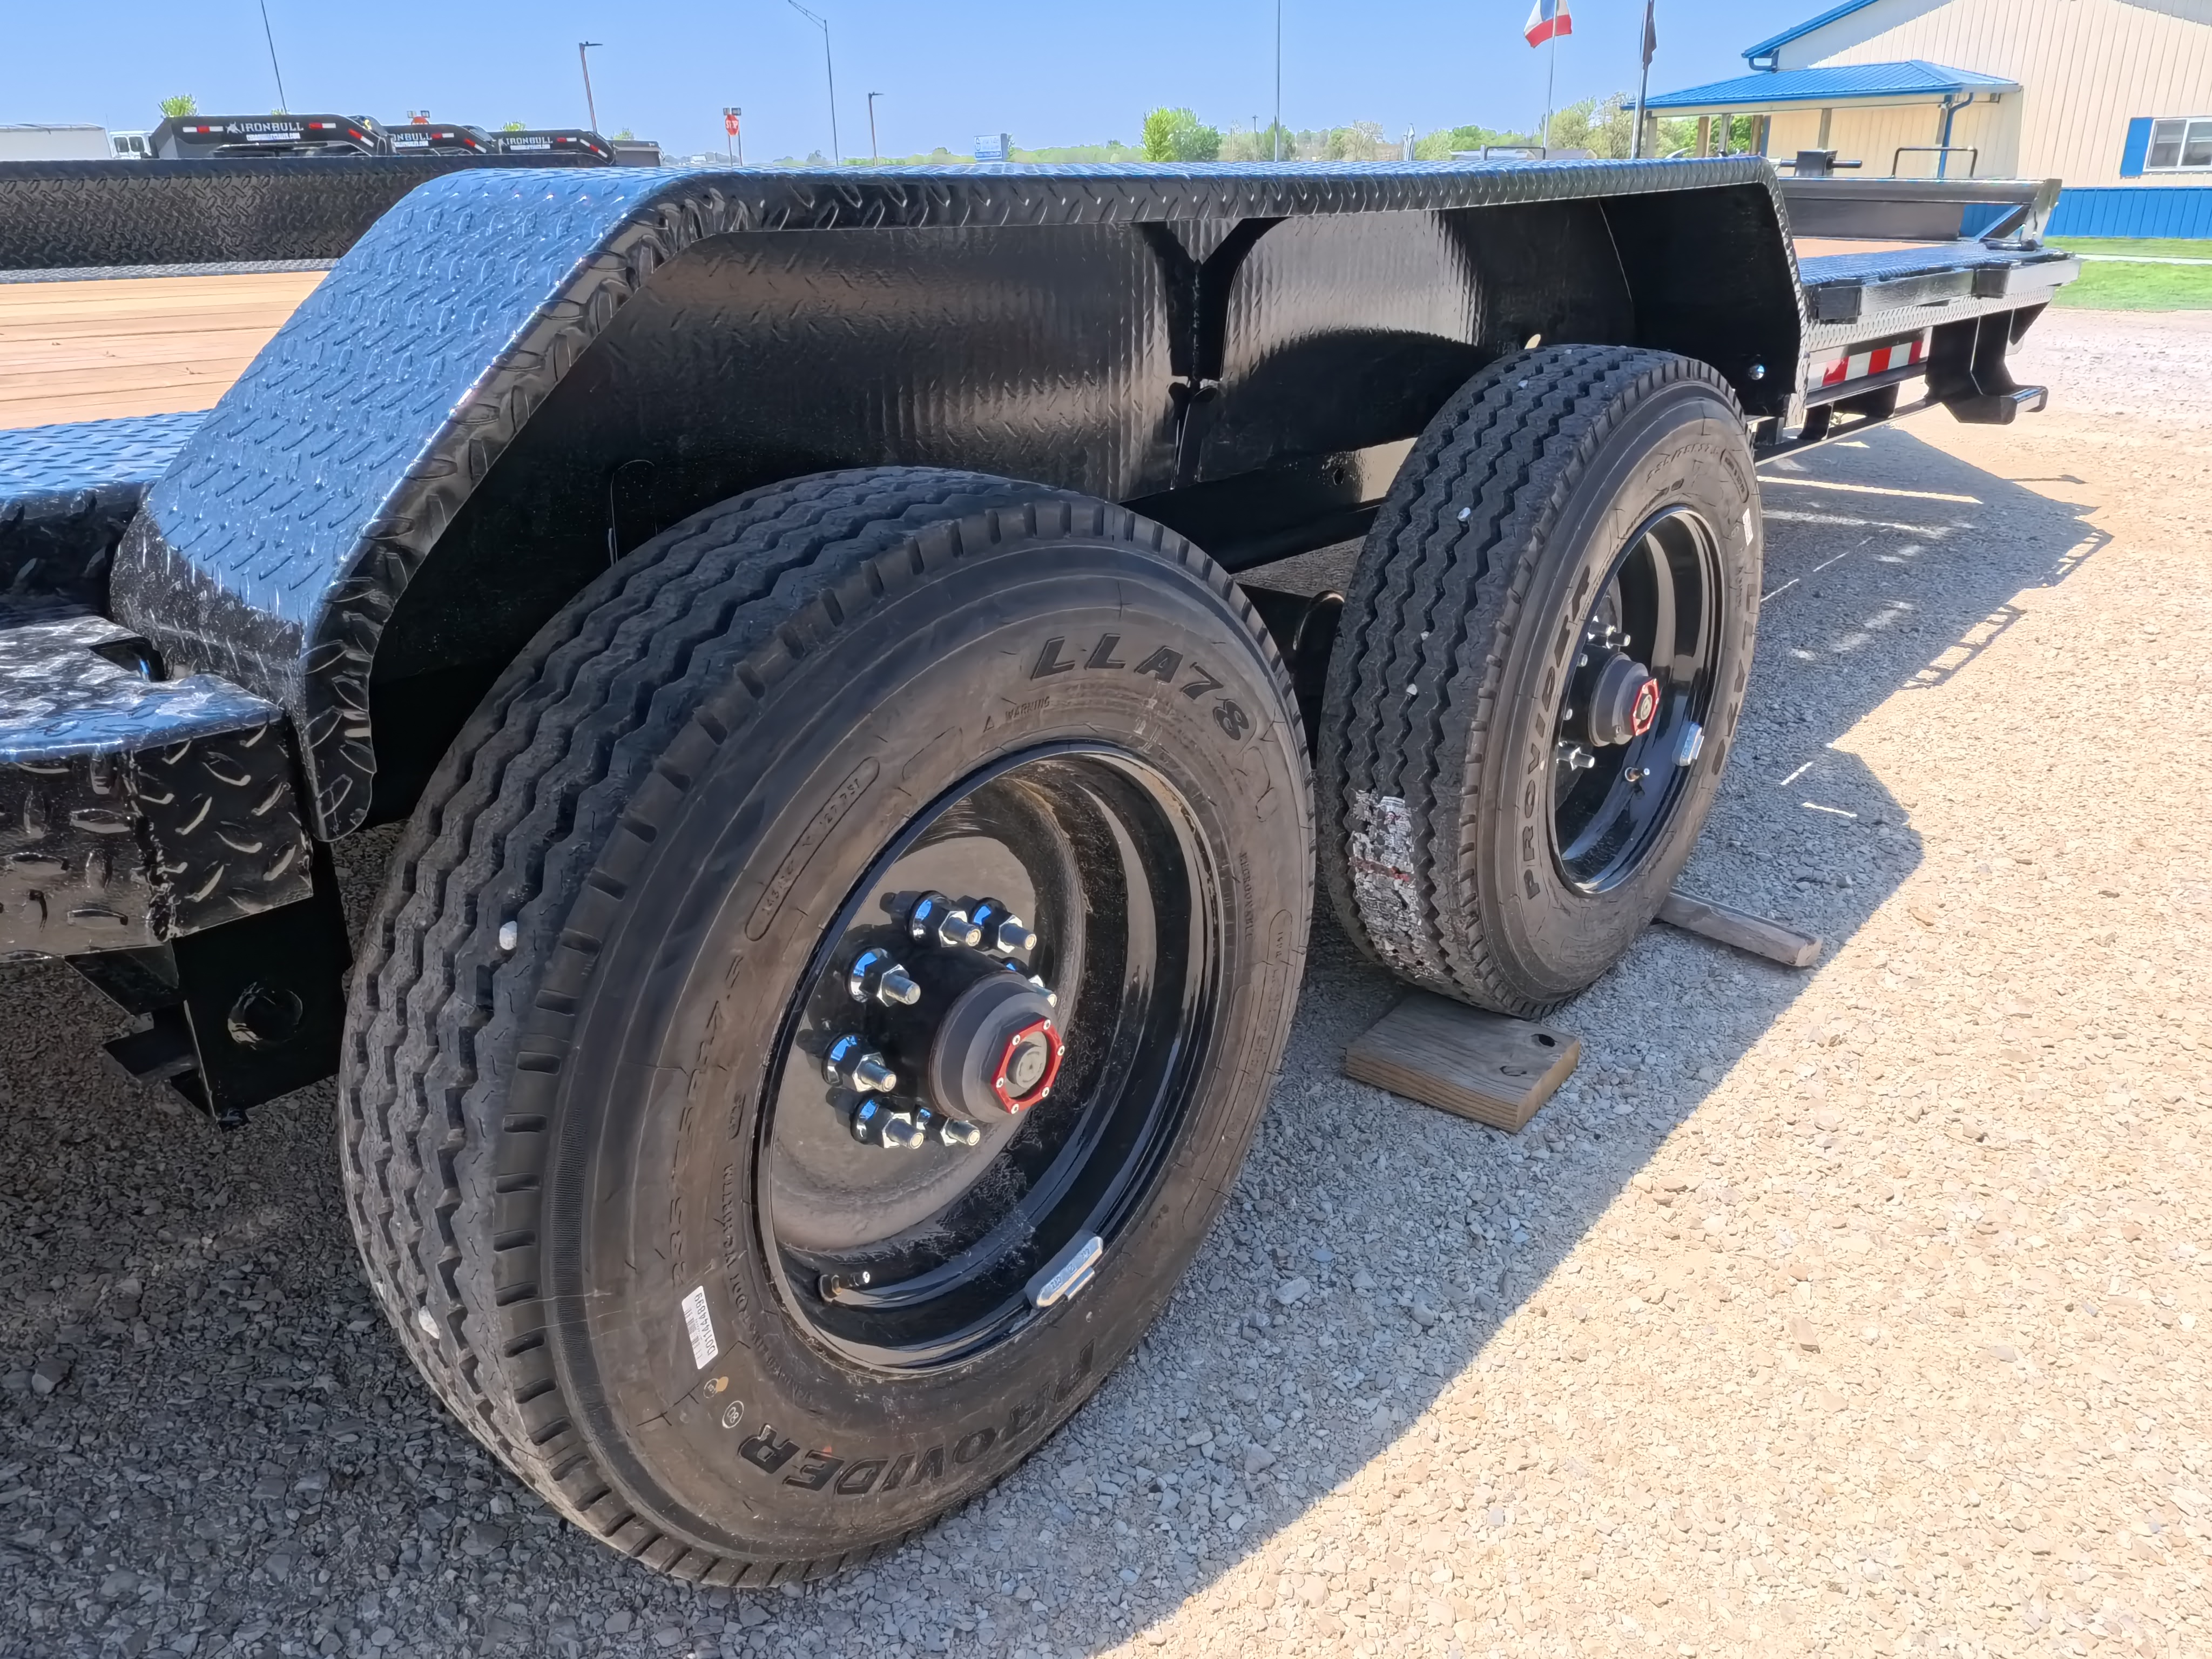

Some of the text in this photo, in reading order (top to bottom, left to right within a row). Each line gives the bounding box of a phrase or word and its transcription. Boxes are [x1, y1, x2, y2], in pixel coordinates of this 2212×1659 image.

[241, 122, 304, 132] IRONBULL
[506, 137, 553, 145] IRONBULL
[1005, 696, 1050, 720] WARNING
[1030, 632, 1250, 740] LLA78
[1522, 565, 1590, 900] PROVIDER
[694, 1292, 716, 1356] D011444899
